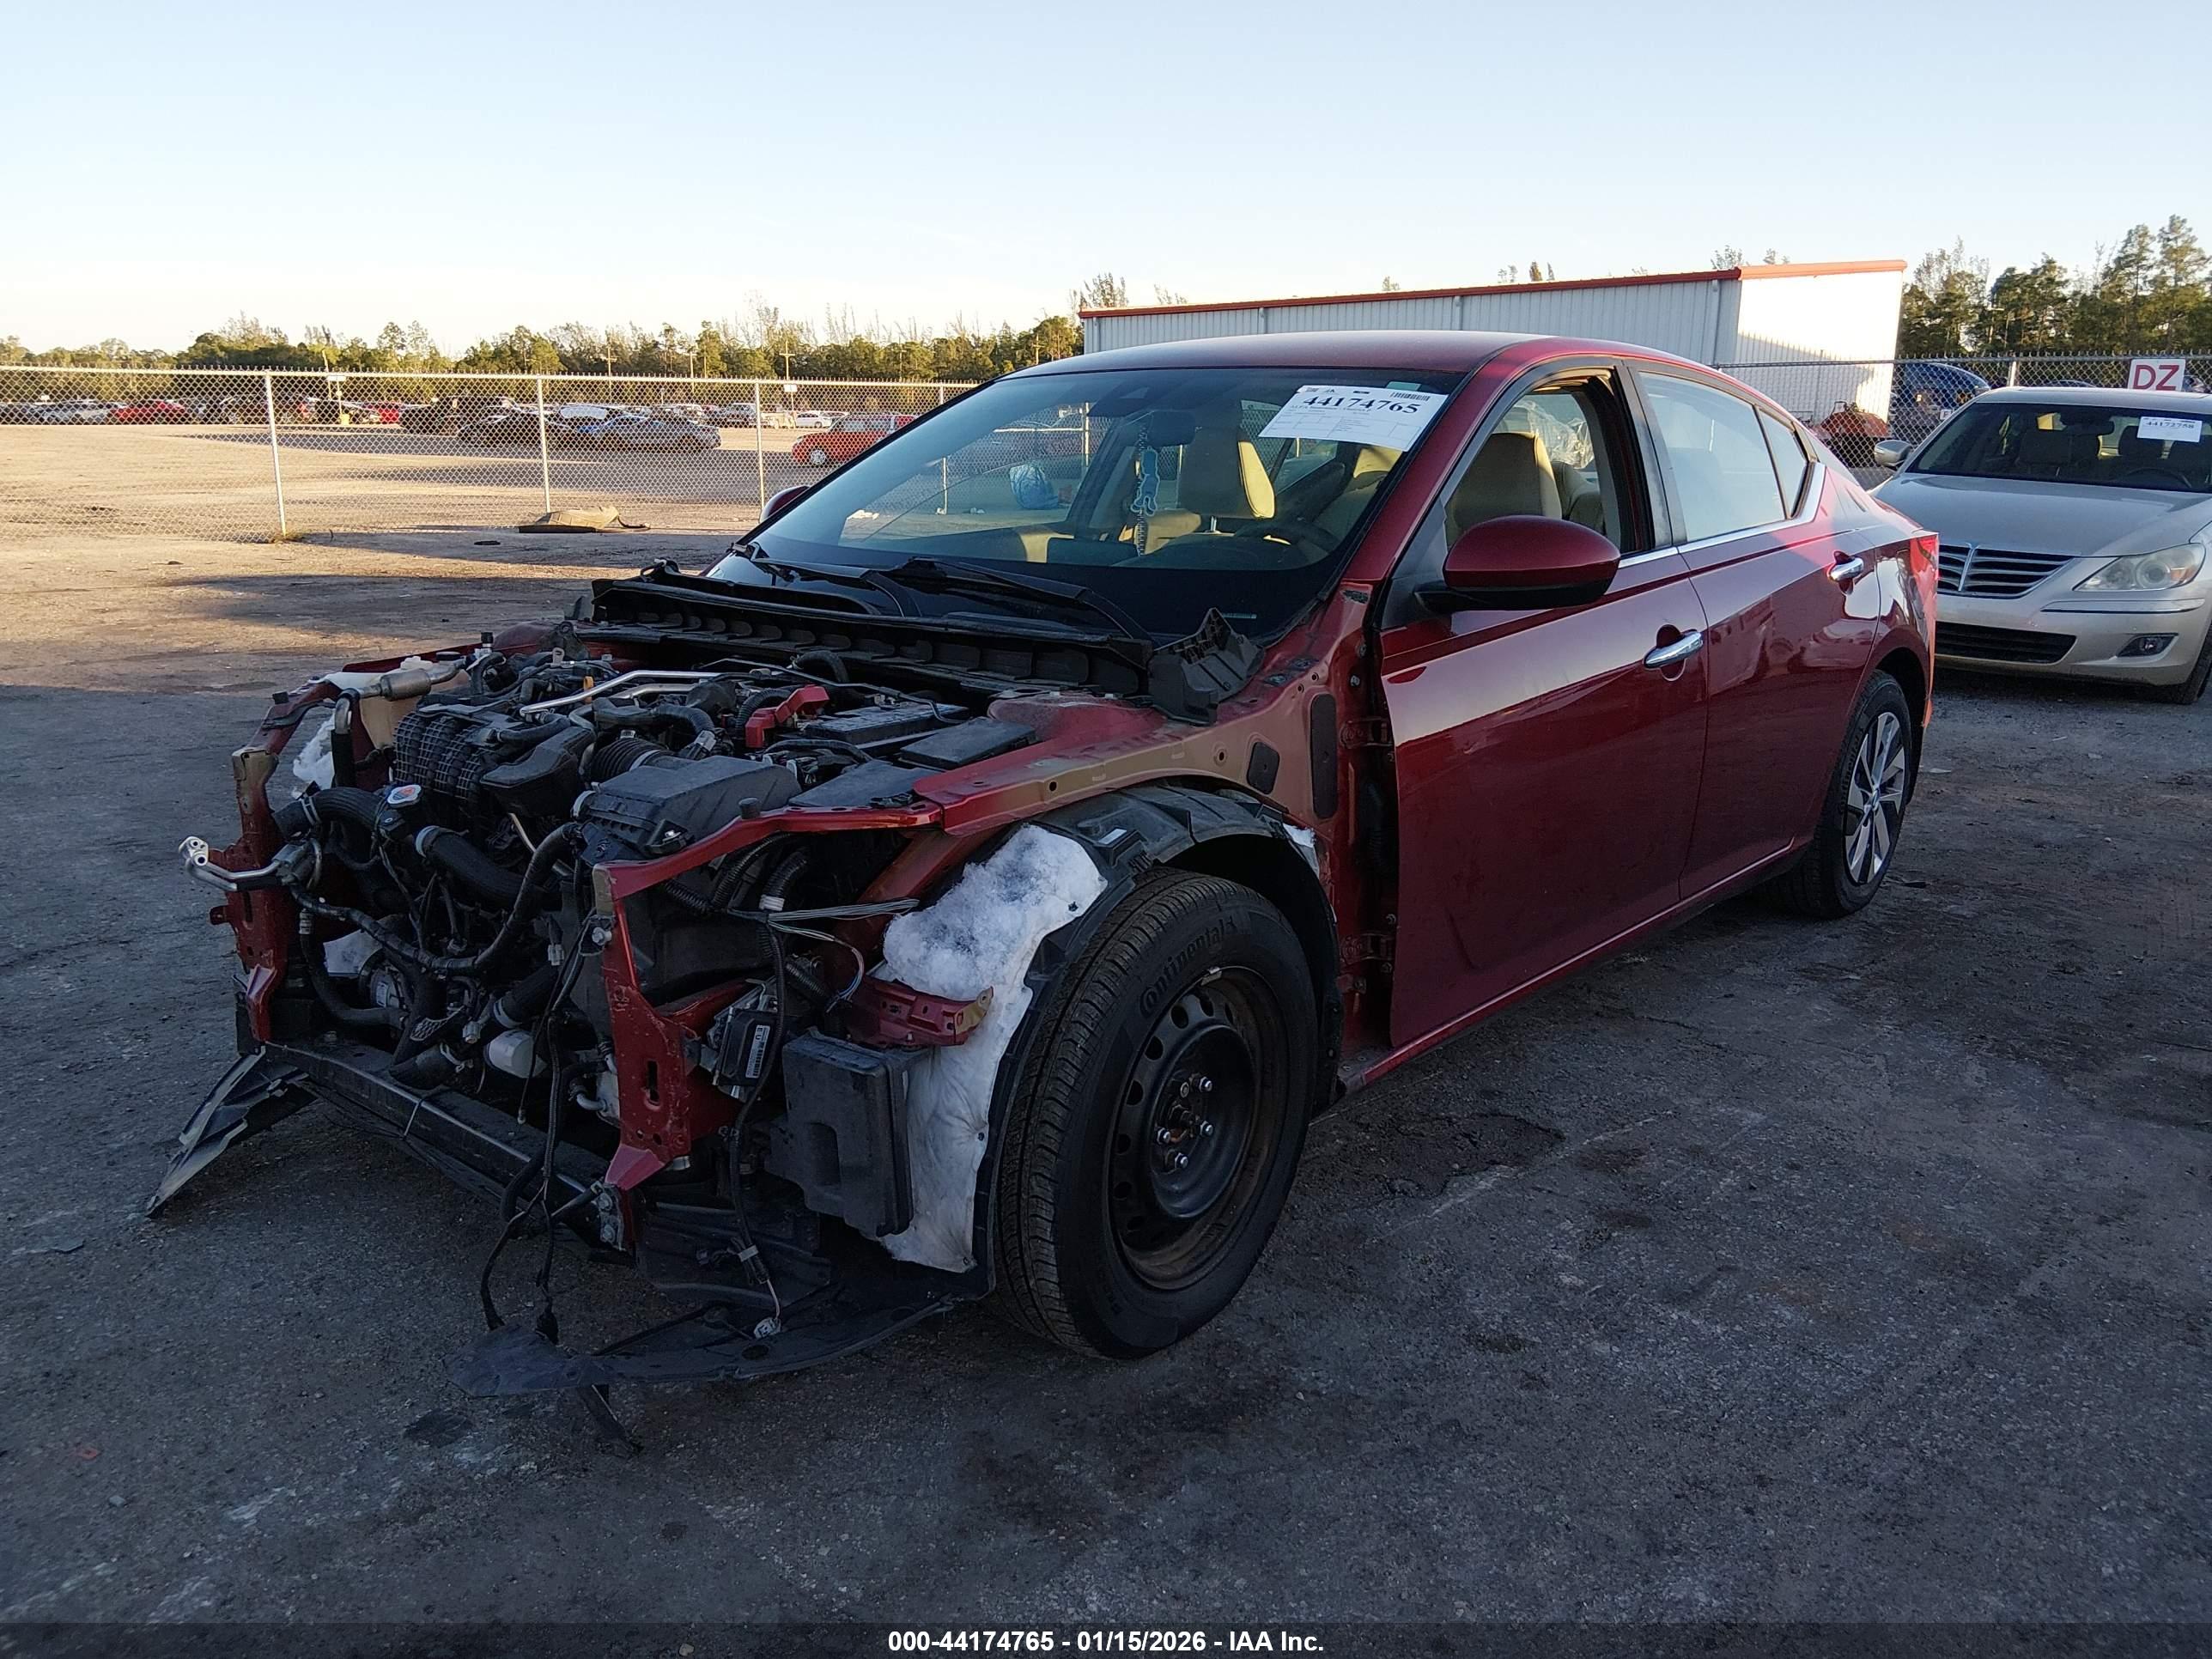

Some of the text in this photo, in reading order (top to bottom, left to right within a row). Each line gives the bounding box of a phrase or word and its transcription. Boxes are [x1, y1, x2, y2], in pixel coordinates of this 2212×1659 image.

[2133, 364, 2180, 391] DZ
[1304, 397, 1421, 414] 44174765
[1139, 918, 1224, 1019] Continental
